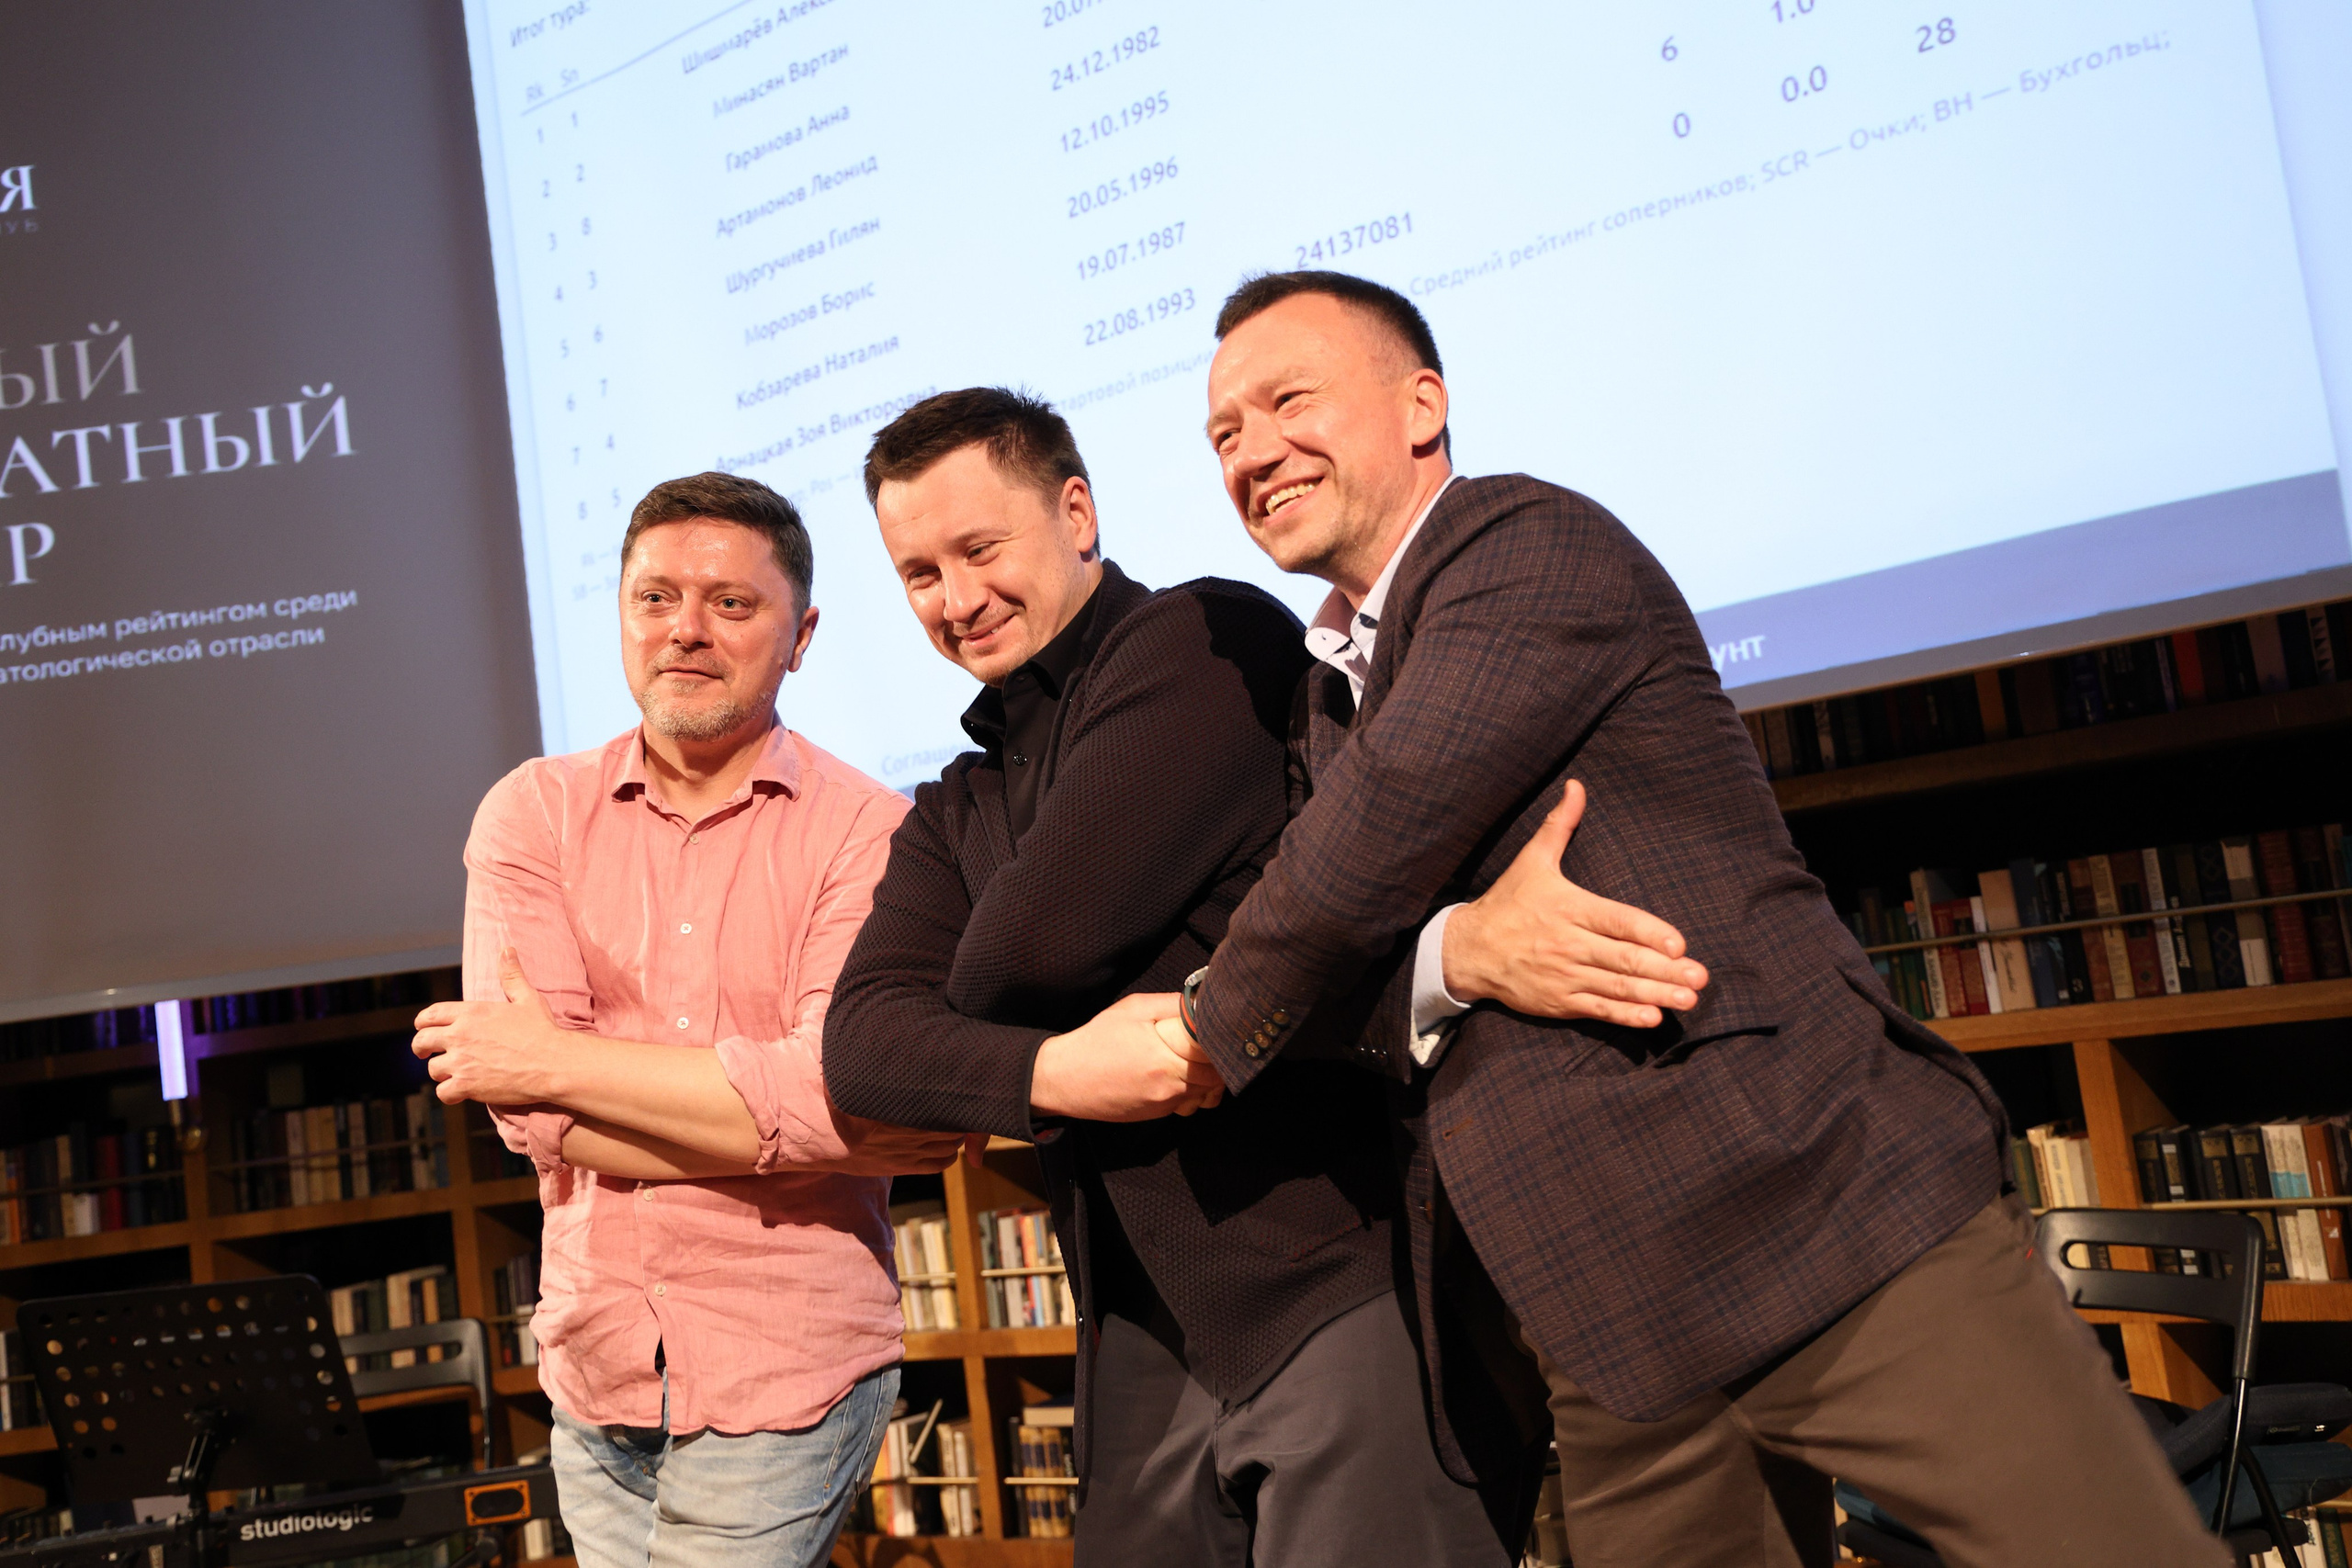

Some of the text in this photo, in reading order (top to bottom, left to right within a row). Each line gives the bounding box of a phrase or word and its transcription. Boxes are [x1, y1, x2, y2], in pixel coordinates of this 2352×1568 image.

[510, 17, 545, 48] Итог
[682, 0, 838, 74] Шишмарёв Алек
[1660, 35, 1679, 62] 6
[1915, 17, 1957, 53] 28
[713, 42, 850, 118] Минасян Вартан
[1050, 26, 1161, 91] 24.12.1982
[1781, 65, 1828, 103] 0.0
[726, 105, 851, 173] Гарамова Анна
[1059, 90, 1170, 152] 12.10.1995
[1672, 112, 1691, 139] 0
[542, 164, 584, 198] 2 2
[1067, 156, 1179, 219] 20.05.1996
[1408, 252, 1504, 298] Средний
[1509, 220, 1597, 268] рейтинг
[1602, 173, 1757, 231] соперников;
[1760, 149, 1810, 183] SCR
[1848, 112, 1929, 151] Очки;
[2019, 30, 2172, 94] Бухгольц;
[716, 154, 879, 239] Артамонов Леонид
[548, 219, 591, 250] 3 8
[725, 216, 881, 295] Шургучиева Гилян
[1077, 221, 1186, 281] 19.07.1987
[1295, 211, 1413, 269] 24137081
[554, 272, 597, 301] 4 3
[745, 280, 876, 346] Морозов Борис
[1083, 288, 1196, 346] 22.08.1993
[561, 325, 603, 357] 5 6
[567, 378, 608, 412] 6 7
[736, 336, 900, 410] Кобзарева Наталия
[0, 381, 358, 499] АТНЫЙ
[572, 434, 615, 465] 7 4
[797, 423, 826, 447] Зоя
[612, 489, 620, 507] 5
[0, 589, 358, 655] лубным рейтингом среди
[209, 626, 326, 658] отрасли
[881, 743, 976, 776] Соглаше
[240, 1505, 373, 1540] studiologic
